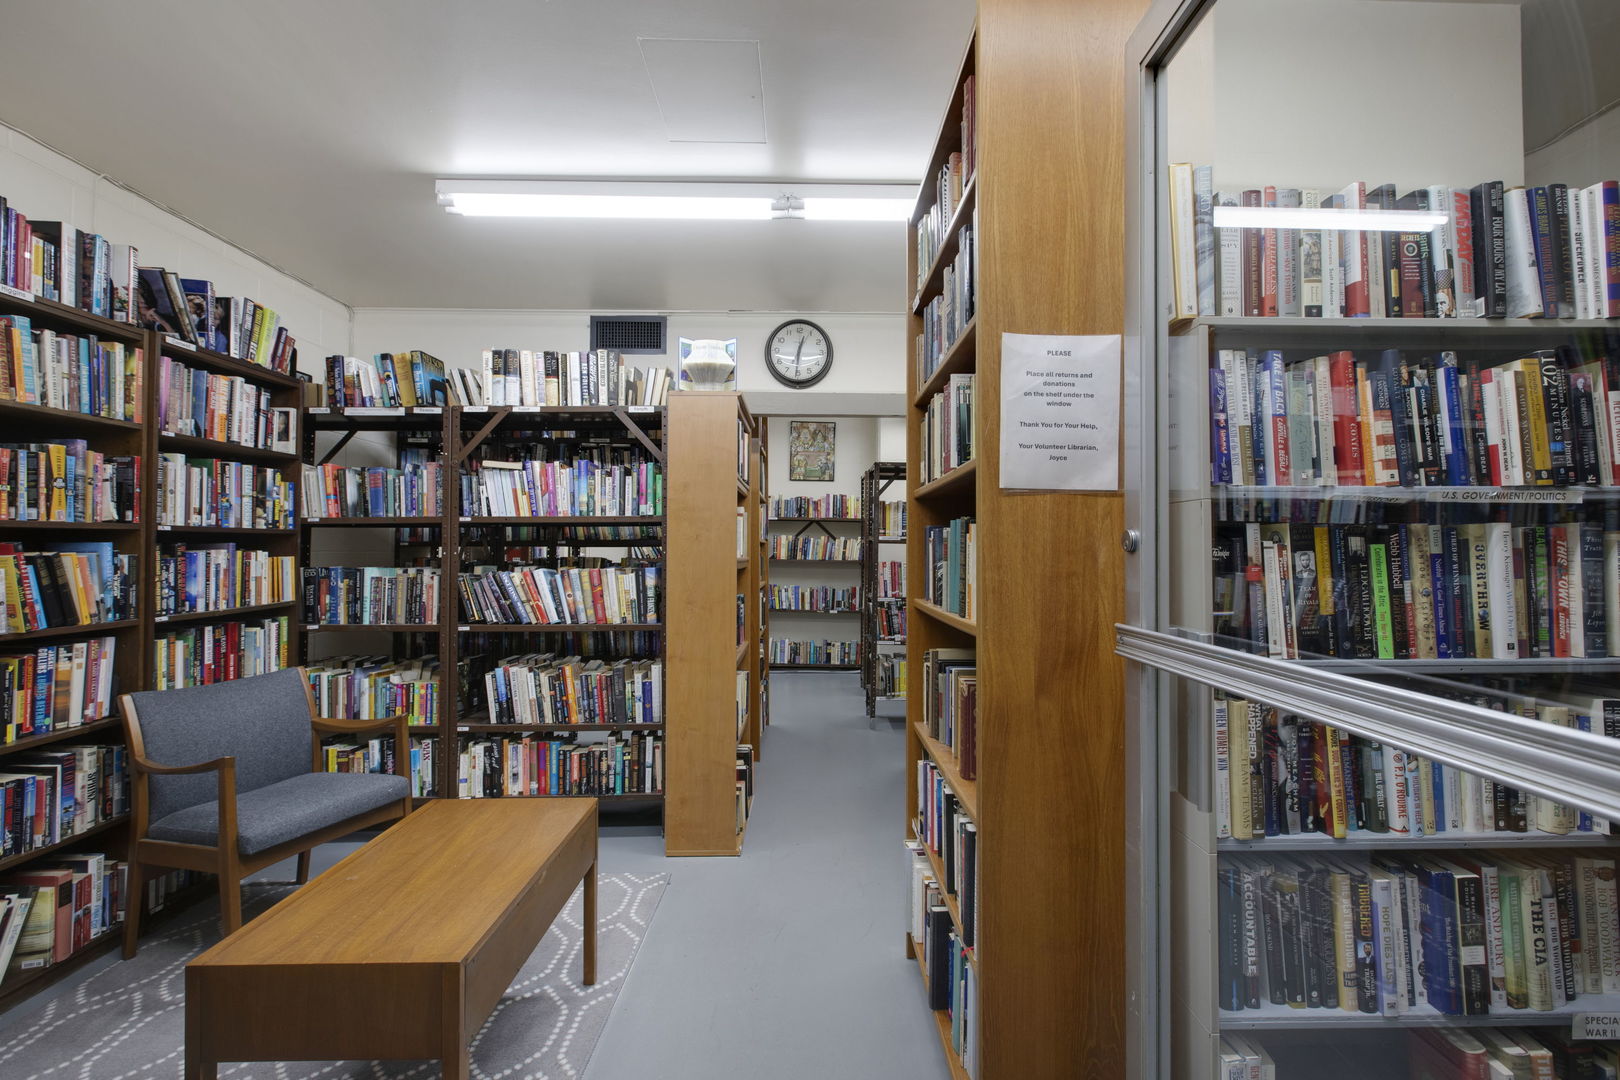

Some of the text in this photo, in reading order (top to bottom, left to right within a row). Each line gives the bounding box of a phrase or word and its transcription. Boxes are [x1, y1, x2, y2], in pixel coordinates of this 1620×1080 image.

[1536, 195, 1547, 214] JAMES
[1454, 192, 1473, 264] MAYDAY
[1538, 216, 1548, 234] BRADY
[1492, 217, 1505, 294] FOUR HOURS MY LAI
[1273, 353, 1281, 377] TAKE
[1392, 367, 1401, 399] LOYALTY
[1541, 356, 1562, 440] 102 MINUTES
[1275, 389, 1284, 414] BACK
[1560, 407, 1569, 430] Nickel
[1564, 440, 1573, 466] Dimed
[1442, 490, 1566, 500] U.S. GOVERNMENT/POLITICS
[1375, 547, 1383, 578] Confederates
[1390, 533, 1402, 589] Webb Hubbell
[1556, 540, 1569, 608] THIS TOWN
[1452, 563, 1461, 595] WINNING
[1475, 544, 1490, 631] OVERTHROW
[1363, 602, 1372, 640] HOOVER
[37, 648, 48, 673] COLLINS
[35, 700, 46, 727] REVENGE
[1216, 708, 1228, 771] WHEN WOMEN WIN
[1248, 704, 1256, 759] HAPPENED
[1242, 796, 1250, 828] TEAMS
[1376, 785, 1385, 808] O'REILLY
[1396, 782, 1407, 818] O'ROURKE
[1358, 883, 1371, 937] TRIGGERED
[1531, 898, 1545, 934] THE
[1566, 883, 1576, 935] WOODWARD
[1610, 888, 1618, 914] PLAN
[1244, 873, 1256, 973] ACCOUNTABLE
[1382, 906, 1390, 932] HOPE
[1489, 876, 1504, 968] FIRE AND FURY
[1560, 918, 1569, 937] BOB
[1583, 866, 1599, 974] Bob Woodward The Agenda
[1598, 888, 1612, 976] BOB WOODWARD
[1611, 918, 1619, 933] OF
[1384, 936, 1392, 959] DIES
[1534, 937, 1547, 966] CIA
[1552, 946, 1562, 990] WOODWARD
[1562, 940, 1573, 995] WOODWARD
[1585, 1028, 1607, 1037] WAR
